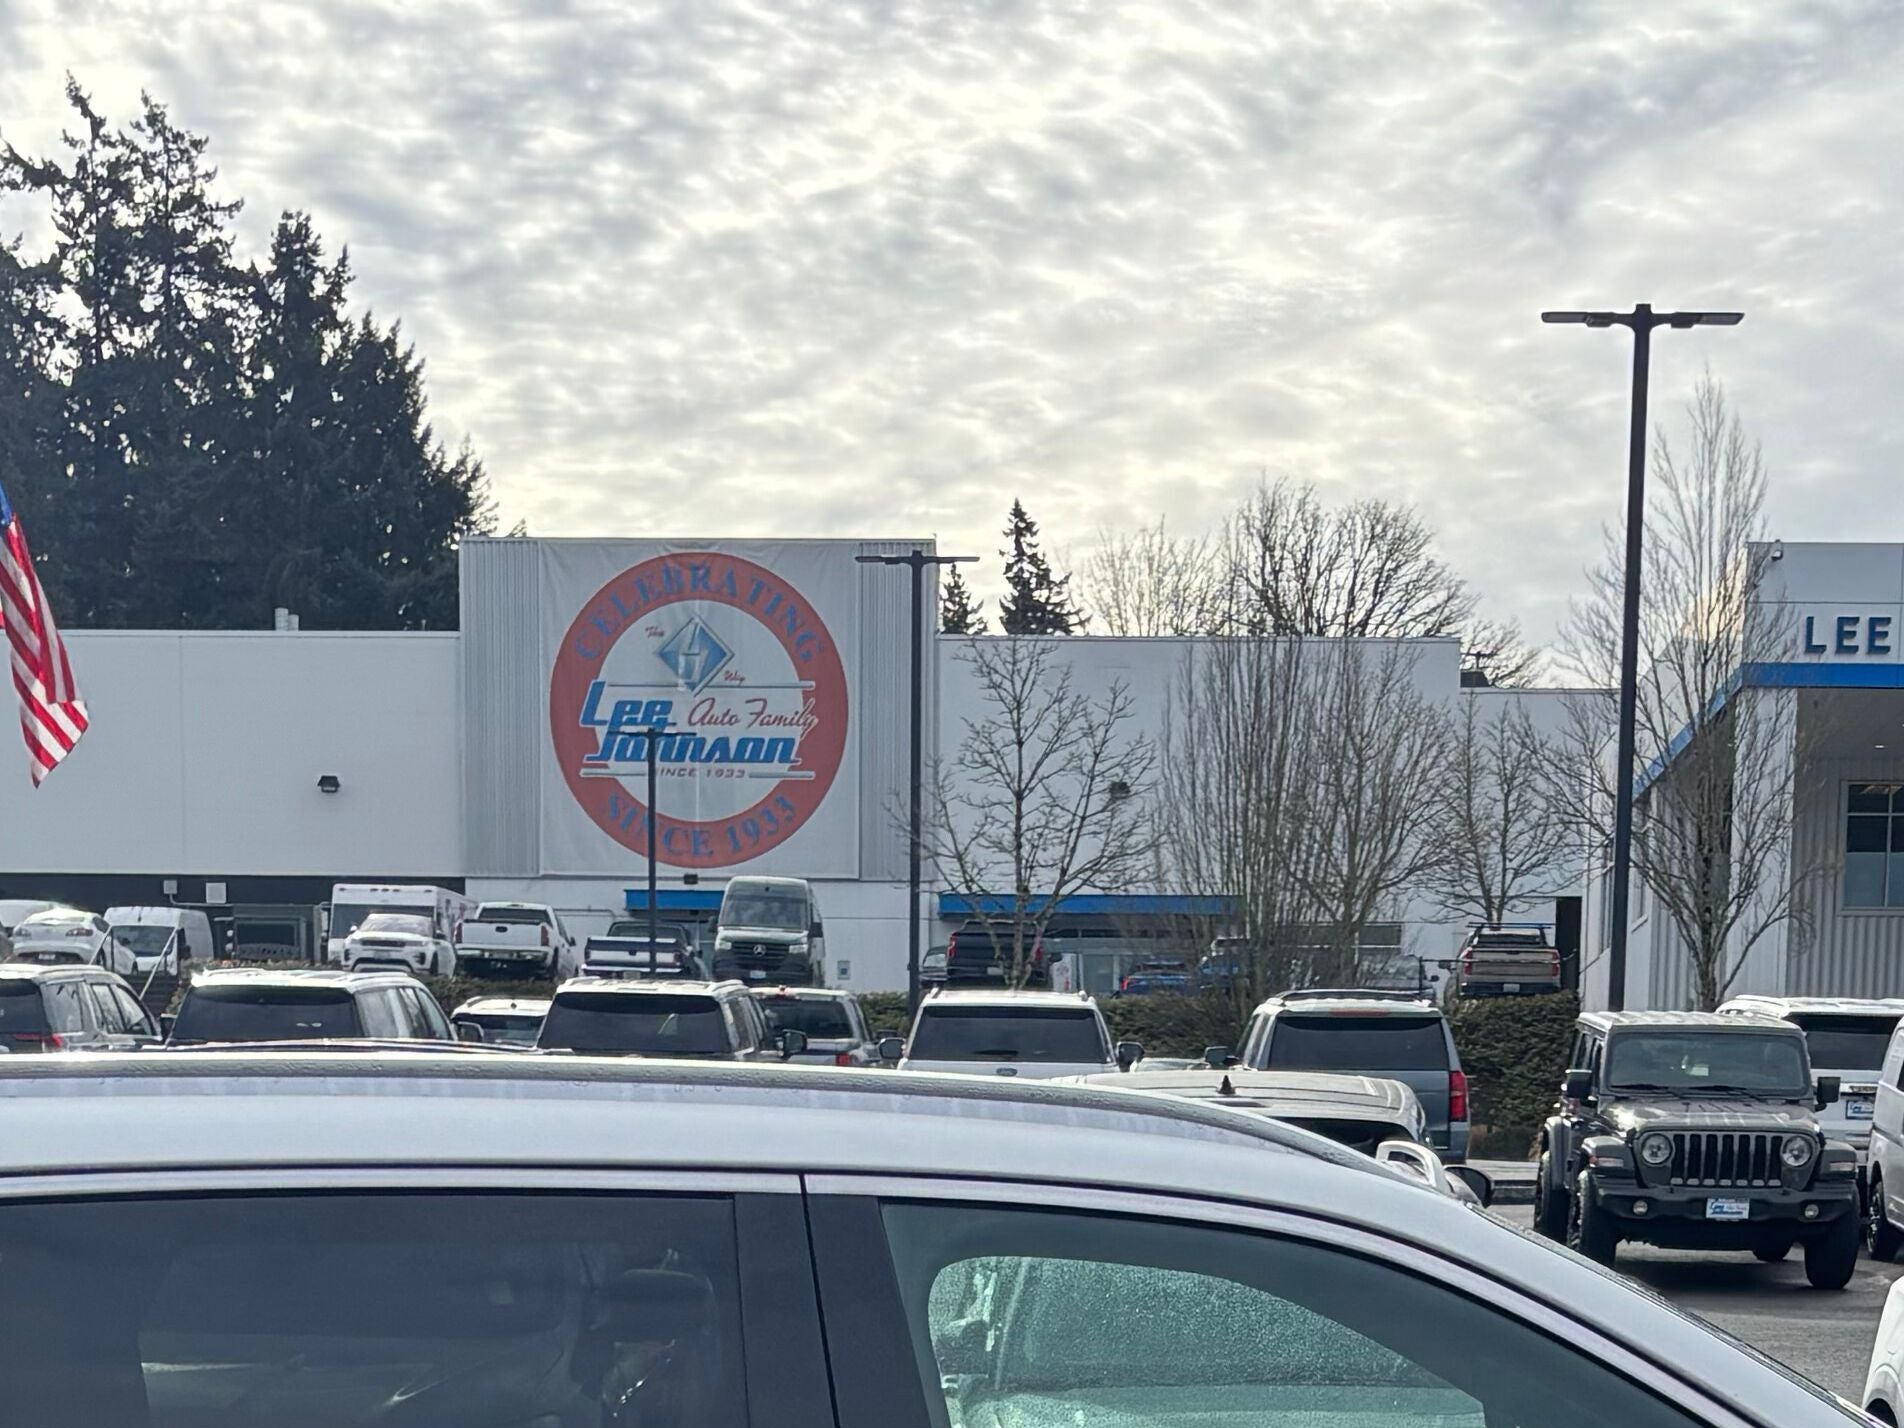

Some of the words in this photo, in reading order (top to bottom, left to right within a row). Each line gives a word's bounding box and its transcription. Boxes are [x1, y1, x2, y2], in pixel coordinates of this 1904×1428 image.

[574, 561, 825, 664] CELEBRATING
[1803, 616, 1893, 655] LEE
[579, 680, 673, 728] Lee
[687, 697, 741, 727] Auto
[745, 697, 819, 740] Family
[654, 767, 697, 778] INCE
[726, 795, 796, 853] 1933
